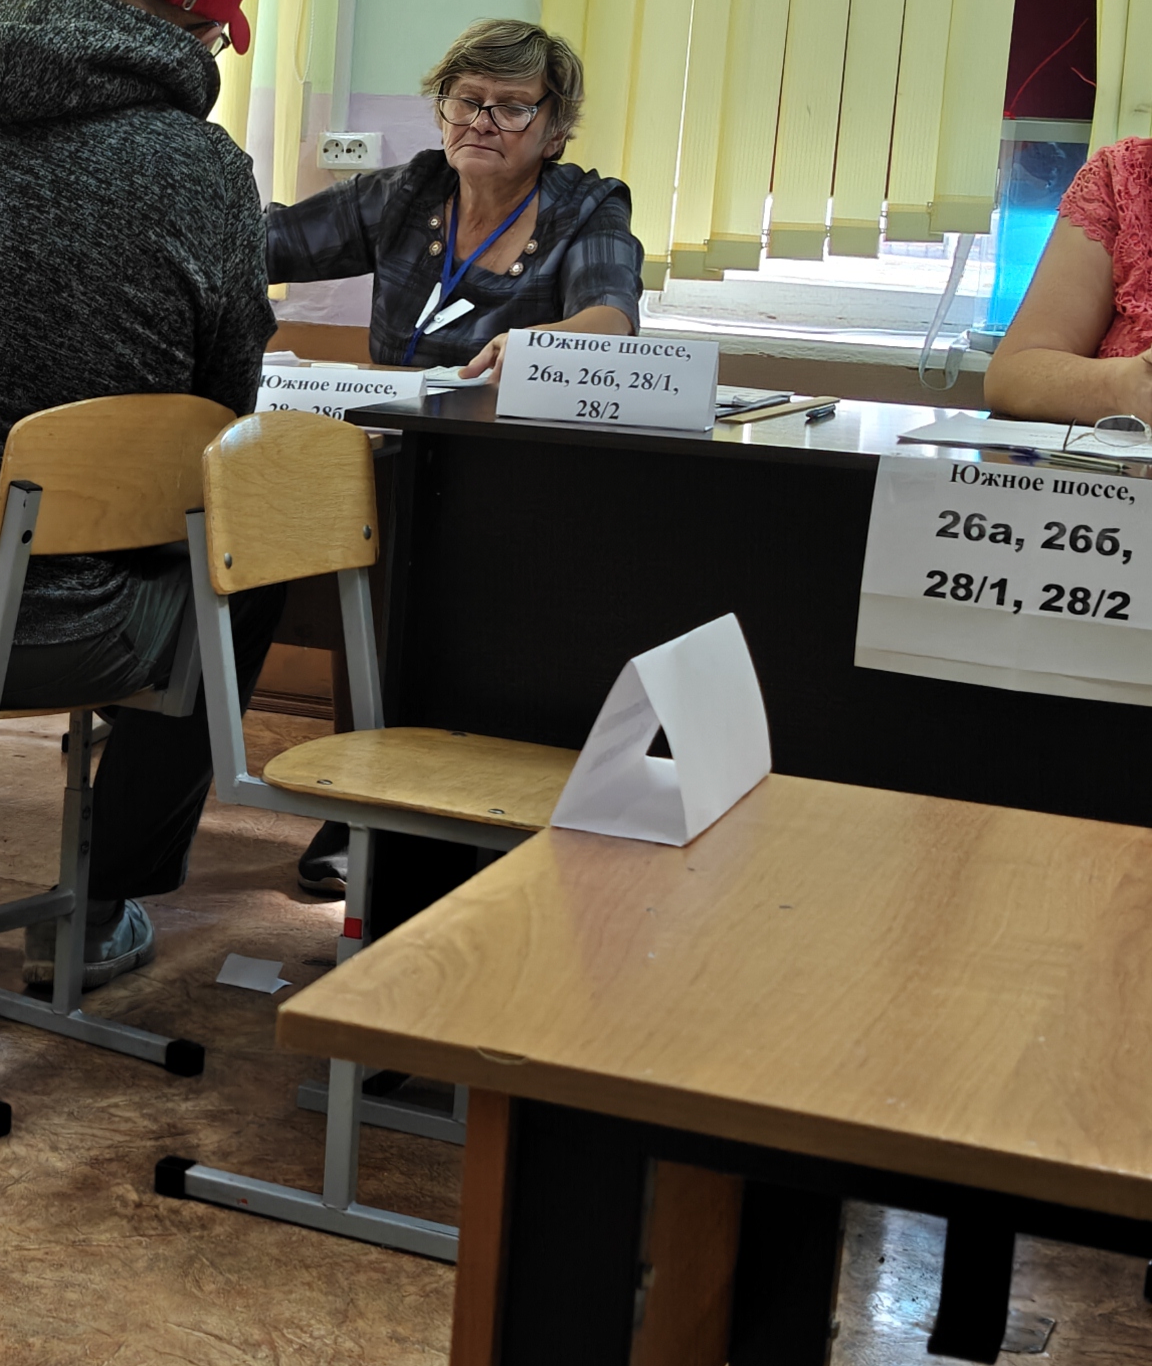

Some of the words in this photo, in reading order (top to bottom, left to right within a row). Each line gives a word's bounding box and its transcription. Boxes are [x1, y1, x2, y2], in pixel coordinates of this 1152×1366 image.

[526, 331, 611, 352] Южное
[618, 340, 692, 361] шоссе,
[259, 374, 330, 392] Южное
[334, 381, 397, 398] шоссе,
[526, 364, 570, 386] 26а,
[577, 367, 621, 391] 26б,
[627, 372, 679, 395] 28/1,
[575, 399, 620, 420] 28/2
[950, 463, 1044, 492] Южное
[1052, 479, 1135, 505] шоссе,
[935, 510, 1025, 553] 26а,
[1040, 521, 1132, 565] 26б,
[923, 569, 1023, 615] 28/1,
[1039, 583, 1131, 620] 28/2
